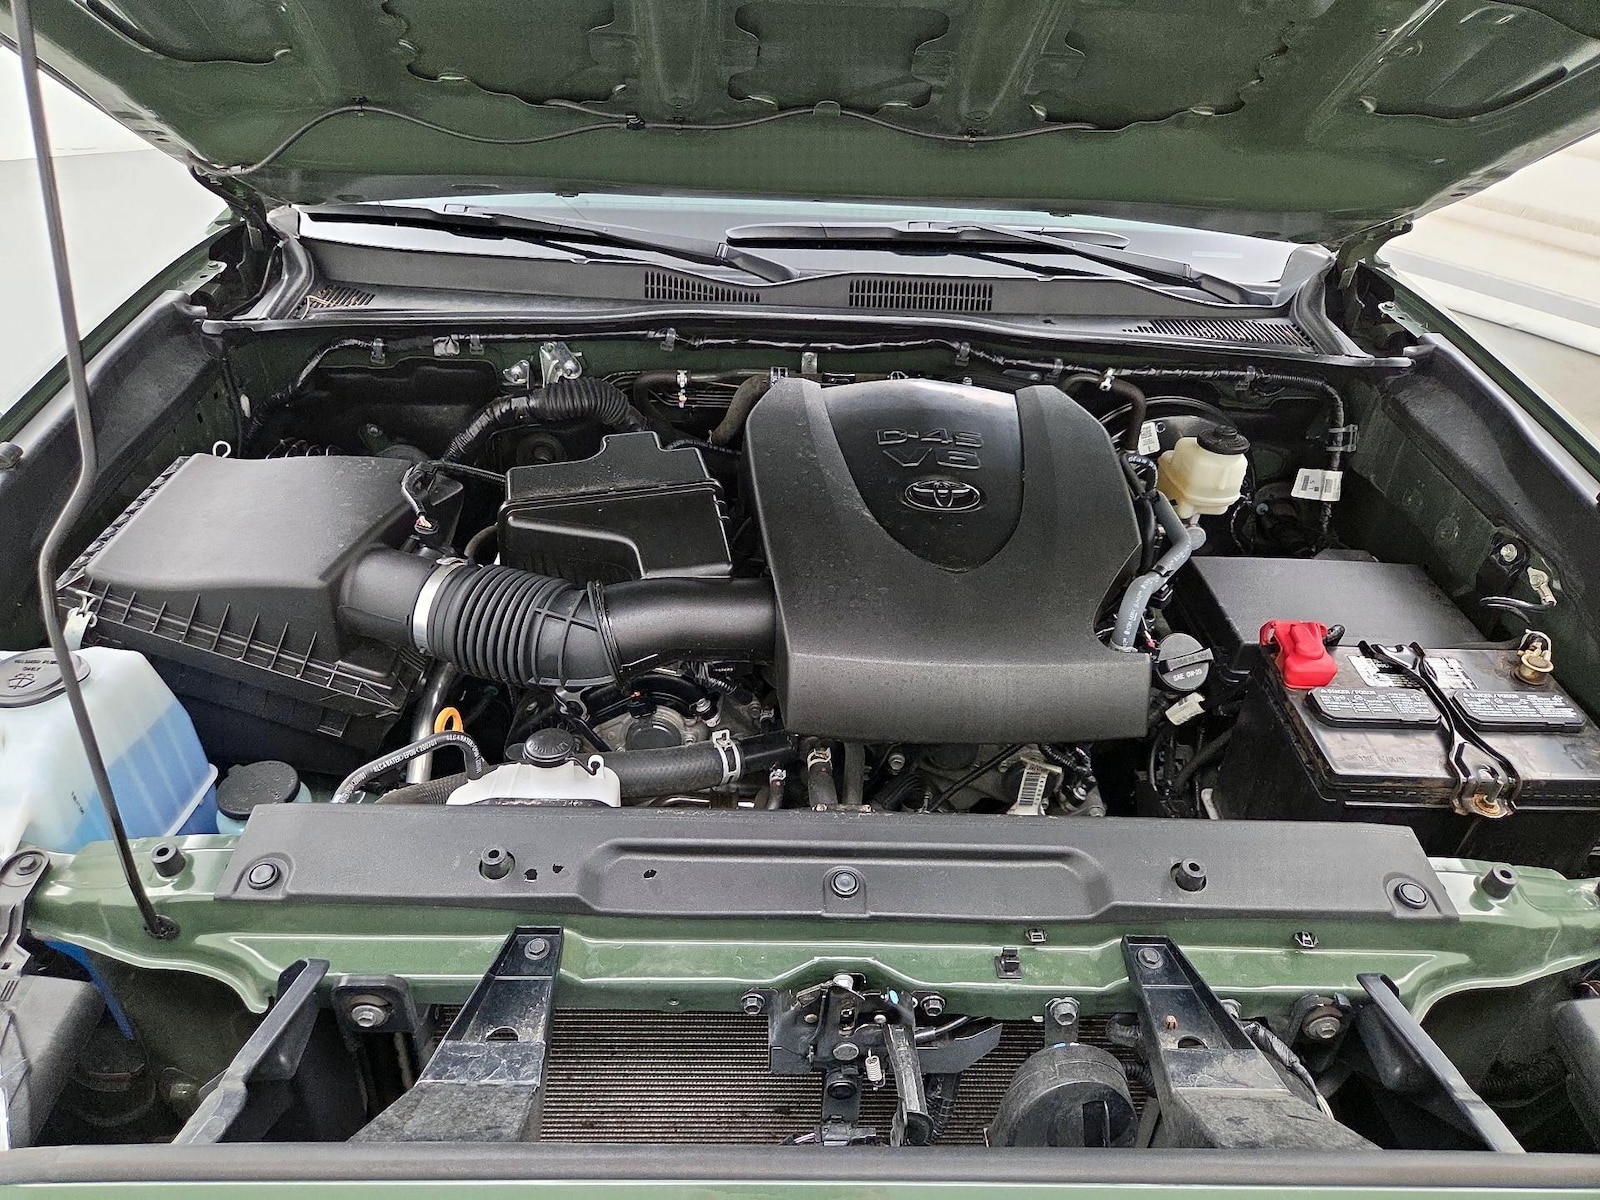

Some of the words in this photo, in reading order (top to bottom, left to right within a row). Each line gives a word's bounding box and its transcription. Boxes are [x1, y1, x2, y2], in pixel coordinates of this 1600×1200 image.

[876, 427, 984, 448] D-4S
[882, 446, 982, 470] V6
[1172, 673, 1186, 682] SAE
